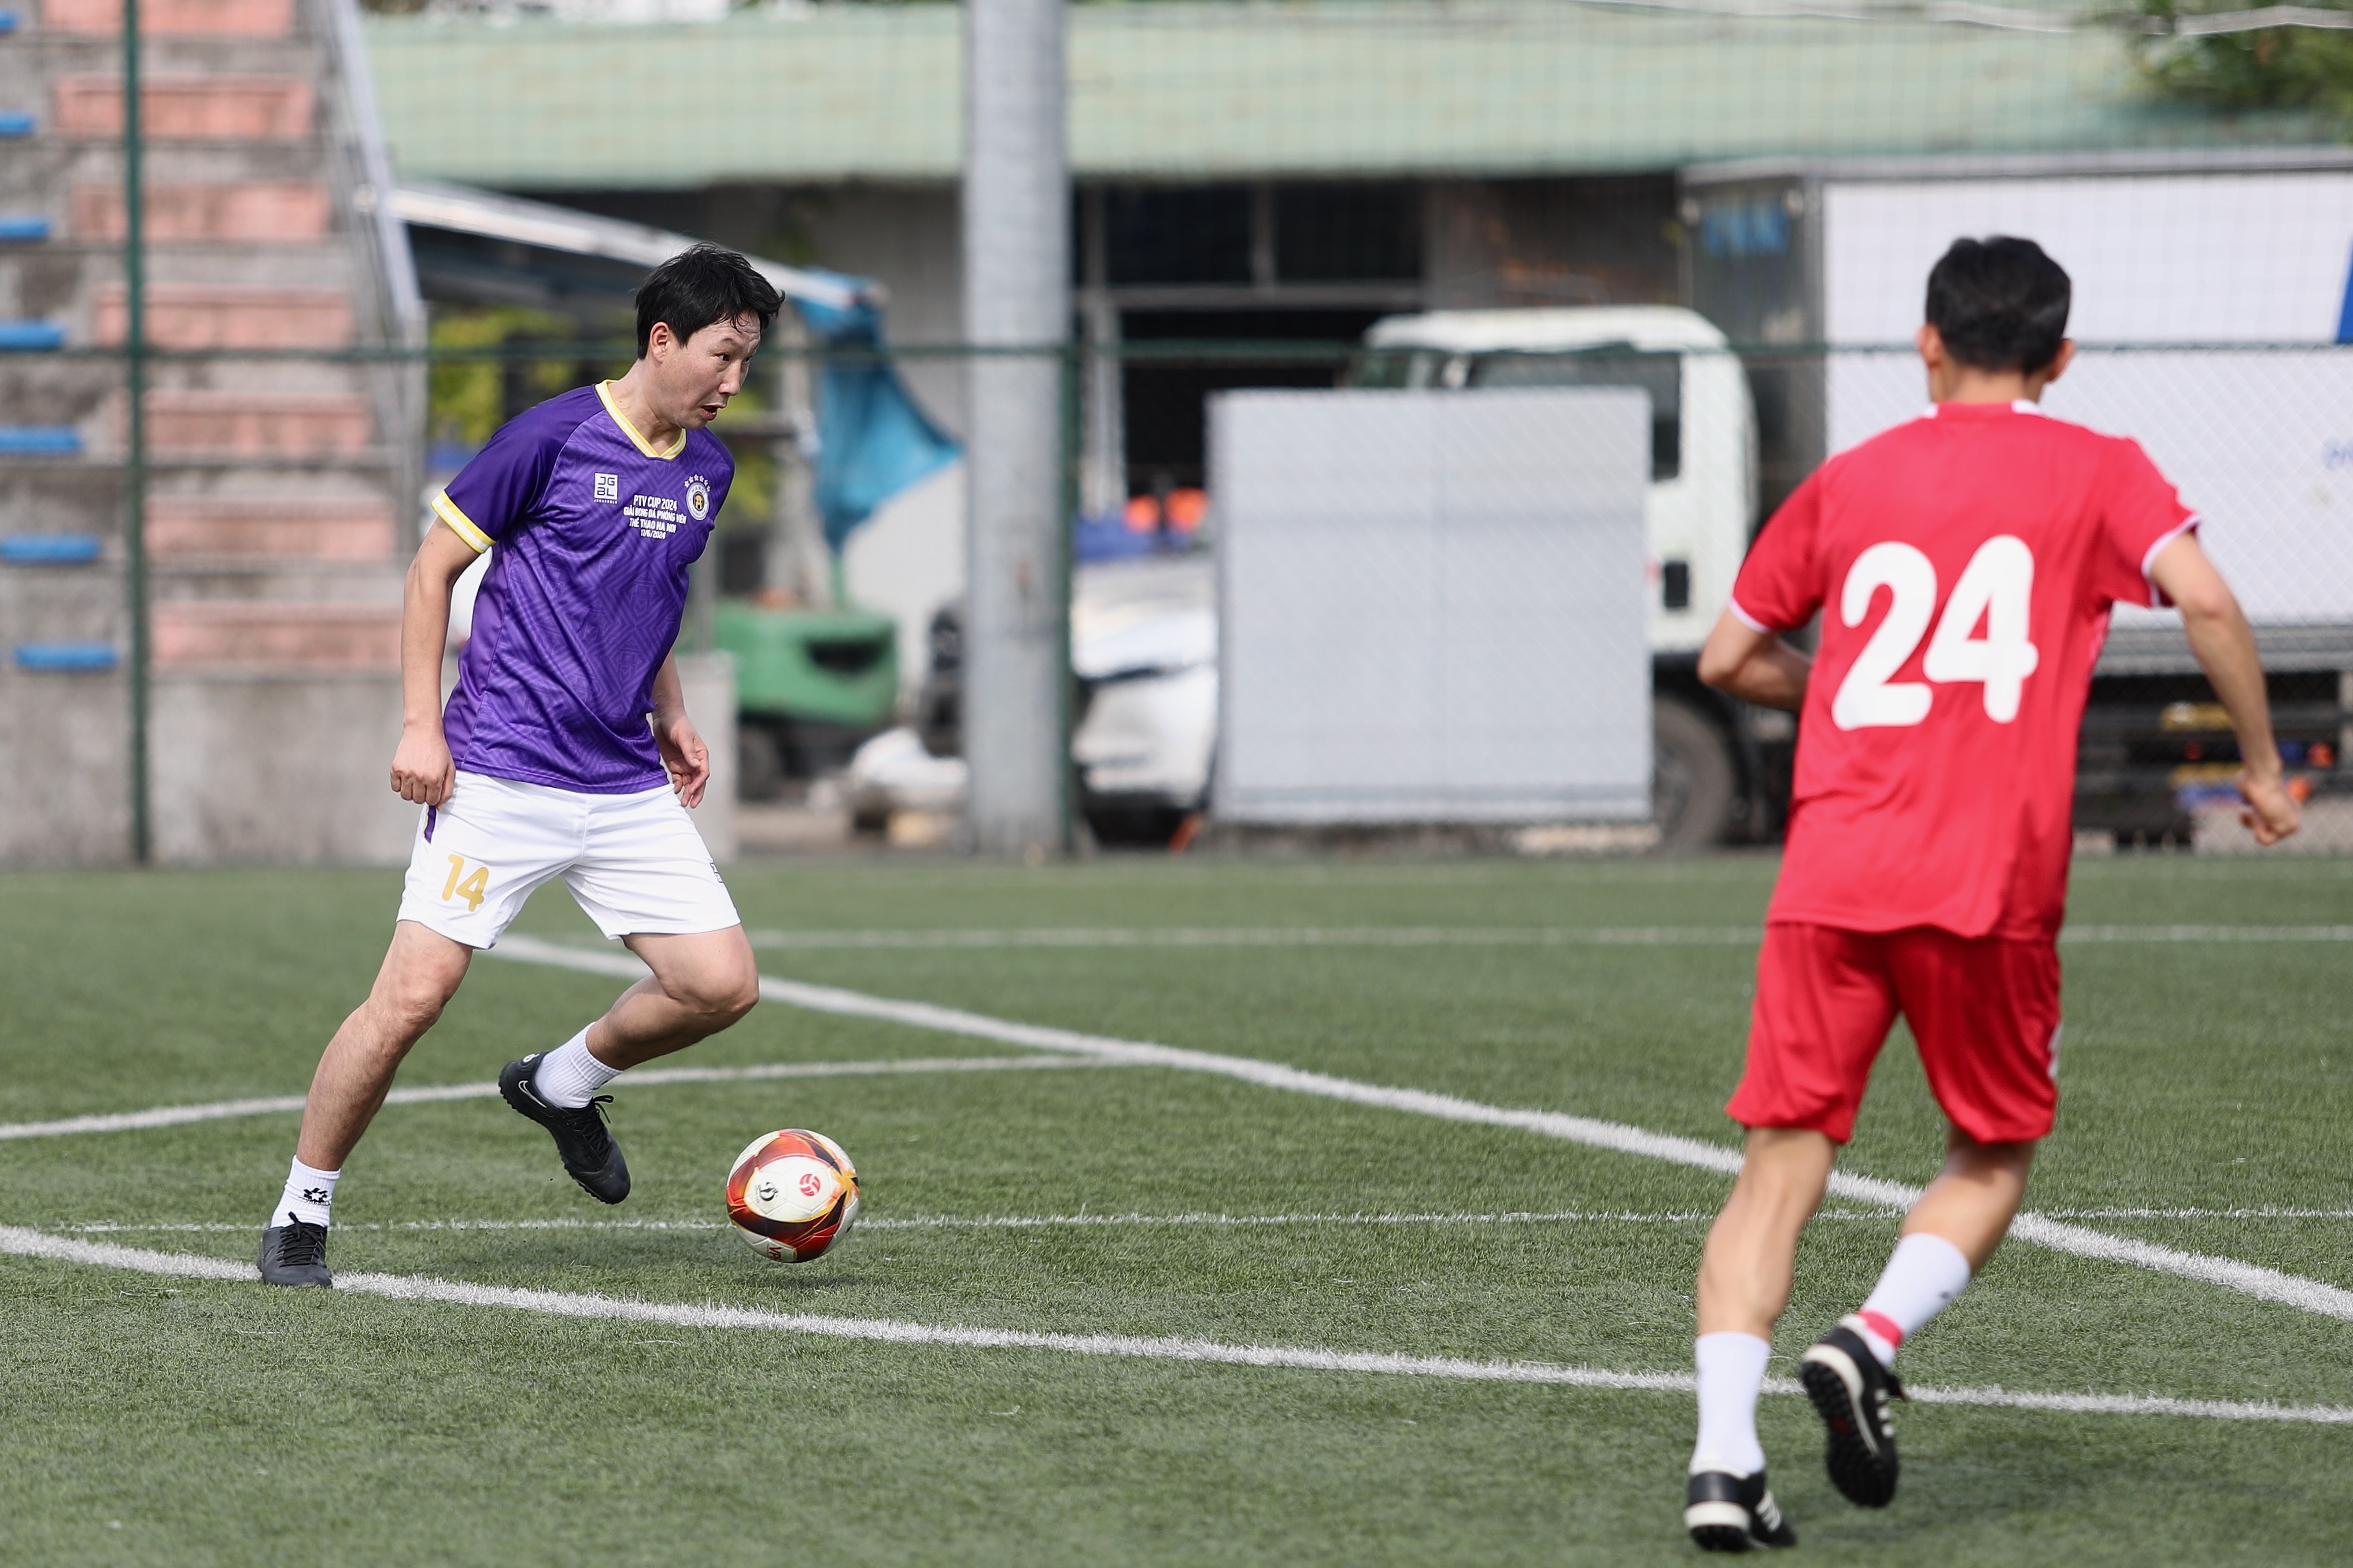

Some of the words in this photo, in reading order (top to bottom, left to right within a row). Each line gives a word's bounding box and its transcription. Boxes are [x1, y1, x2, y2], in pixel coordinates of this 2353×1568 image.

[598, 476, 615, 486] JG
[597, 487, 615, 497] BL
[633, 494, 647, 506] PTV
[648, 496, 661, 508] CUP
[661, 498, 677, 511] 2024
[640, 519, 656, 530] THAO
[640, 529, 666, 539] 17/6/2024
[1831, 534, 2039, 731] 24
[442, 853, 489, 912] 14
